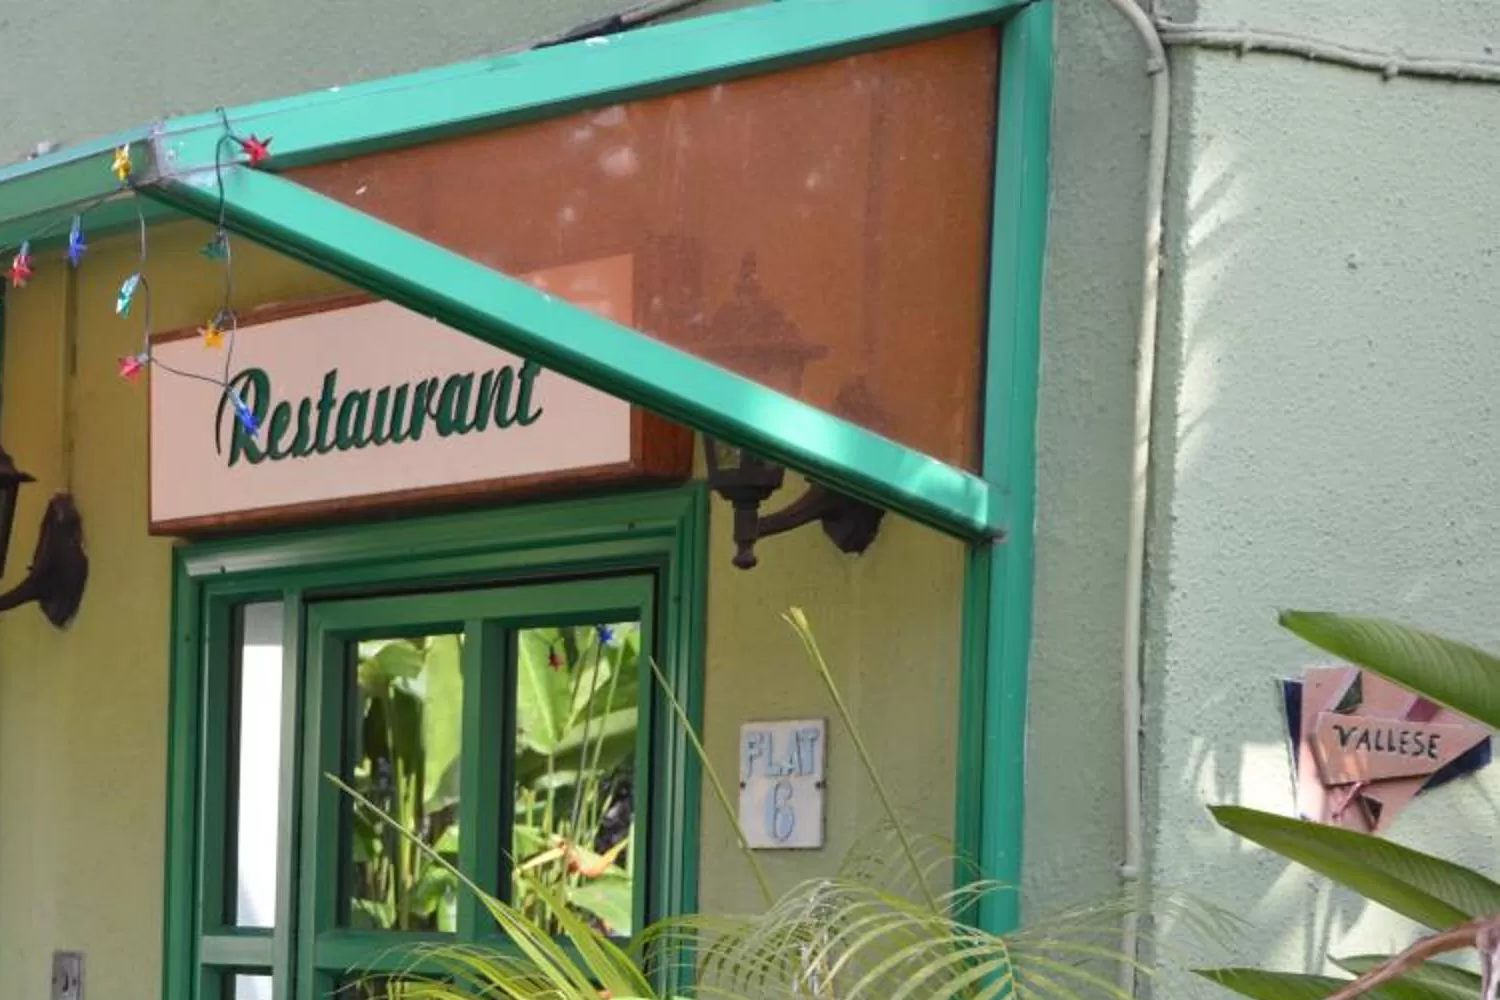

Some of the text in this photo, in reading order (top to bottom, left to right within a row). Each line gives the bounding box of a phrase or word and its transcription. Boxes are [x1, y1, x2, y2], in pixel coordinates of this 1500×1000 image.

[215, 358, 543, 467] Restaurant
[1331, 725, 1441, 759] VALLESE
[765, 780, 795, 843] 6
